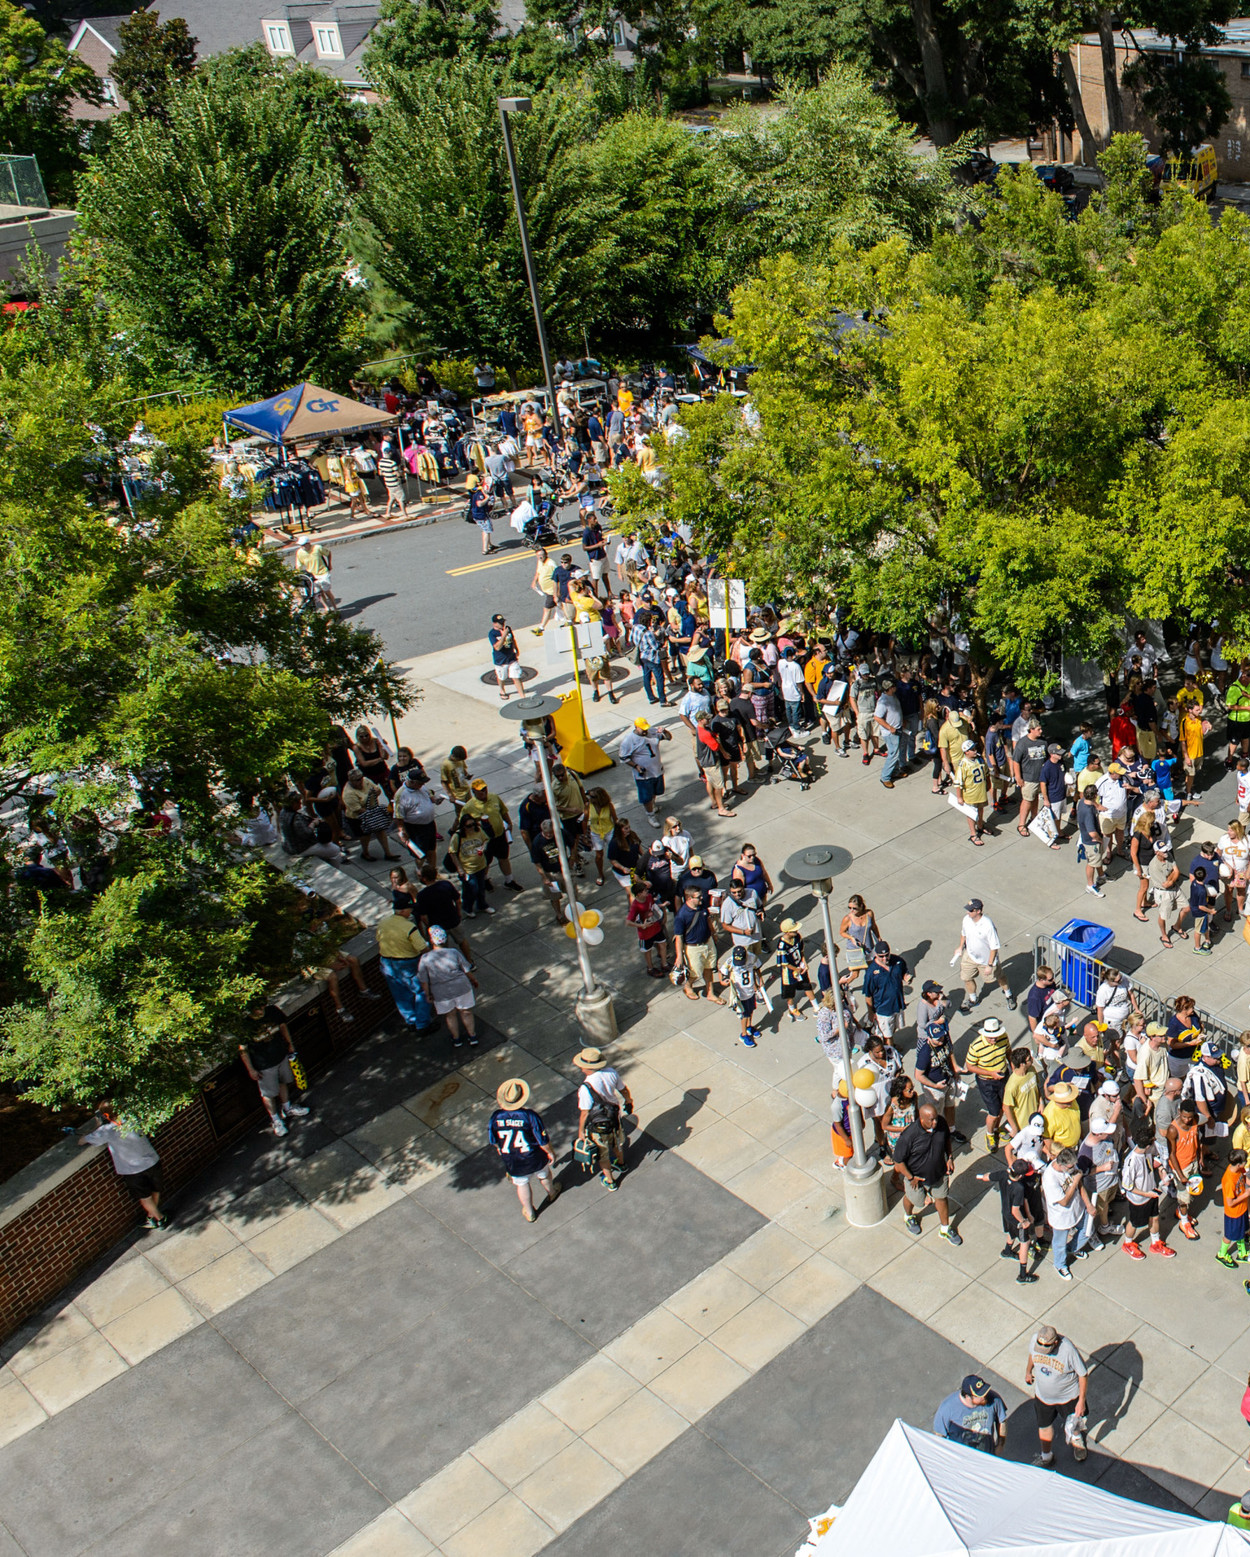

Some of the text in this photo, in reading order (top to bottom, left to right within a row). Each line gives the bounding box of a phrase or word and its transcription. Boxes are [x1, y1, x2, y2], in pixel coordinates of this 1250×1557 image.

[306, 398, 340, 413] GT
[646, 743, 656, 758] 1
[972, 767, 986, 783] 21
[1225, 846, 1247, 858] GT
[741, 970, 750, 986] 8
[497, 1129, 530, 1154] 74
